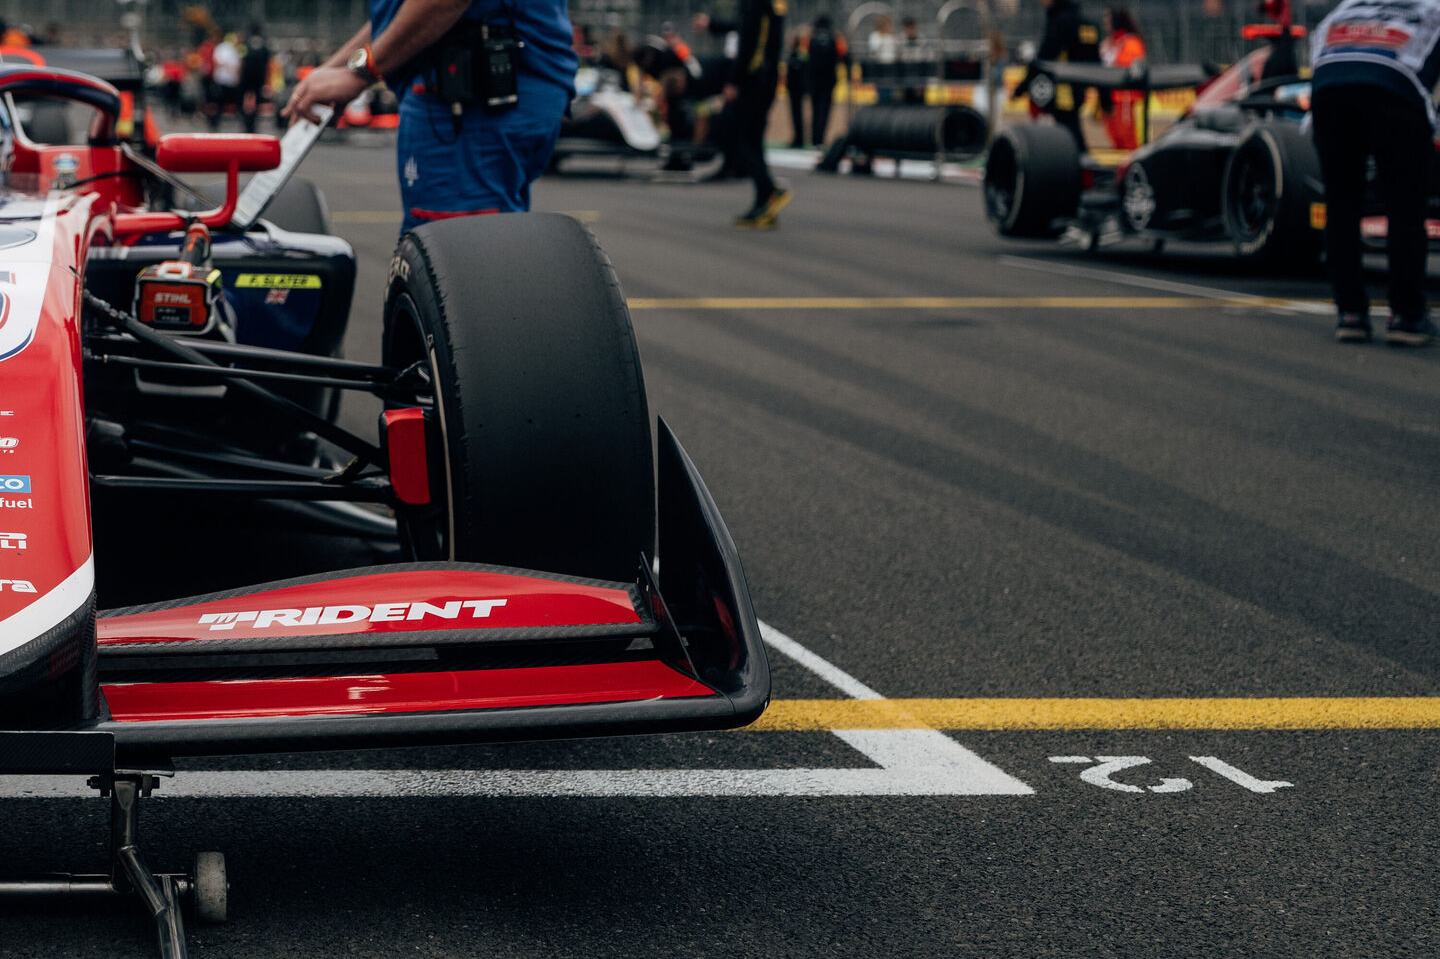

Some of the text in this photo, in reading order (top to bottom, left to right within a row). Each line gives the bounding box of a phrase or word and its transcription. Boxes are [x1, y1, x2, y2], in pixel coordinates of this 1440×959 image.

[154, 292, 192, 305] STIHL
[197, 598, 508, 631] TRIDENT
[1047, 755, 1295, 793] 12
